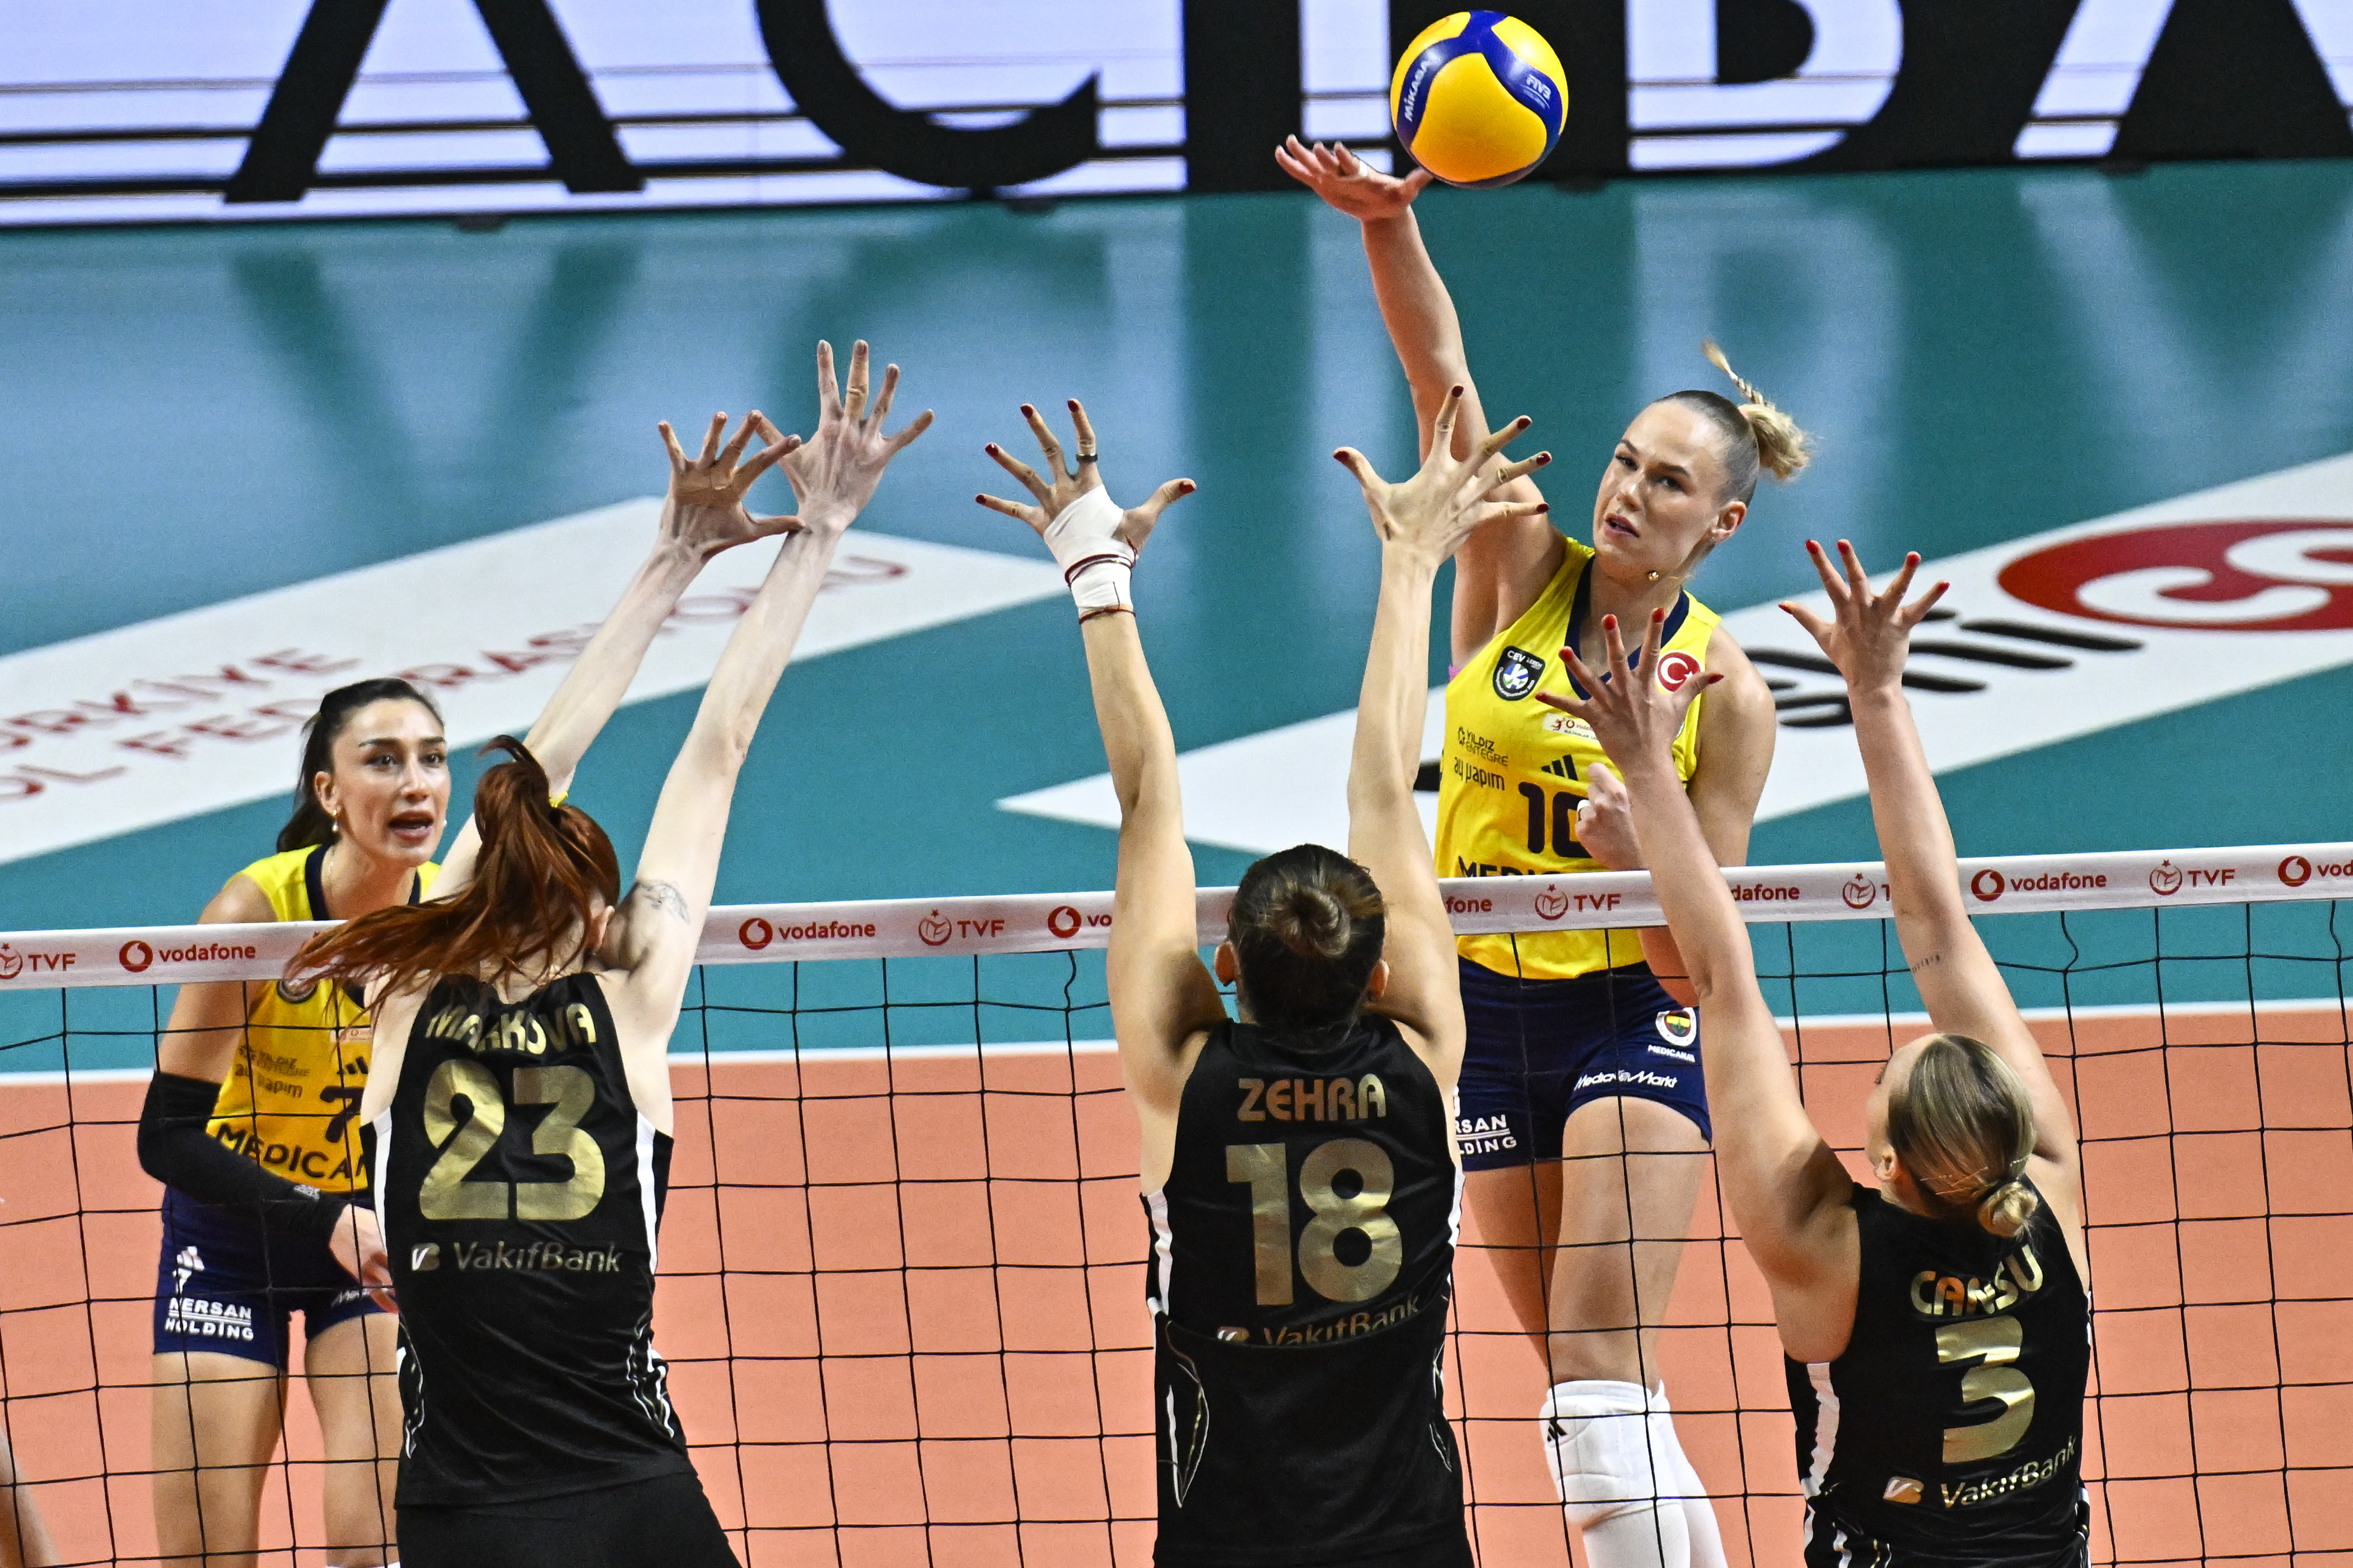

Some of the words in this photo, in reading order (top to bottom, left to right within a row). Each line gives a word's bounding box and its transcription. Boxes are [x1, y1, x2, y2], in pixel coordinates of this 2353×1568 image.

[1507, 650, 1526, 662] CEV
[1466, 742, 1509, 766] ENTEGRE
[1467, 729, 1495, 751] YILDIZ
[1574, 893, 1621, 911] TVF
[2011, 872, 2107, 891] vodafone
[2188, 869, 2235, 887] TVF
[779, 920, 876, 940] vodafone
[957, 920, 1005, 938] TVF
[28, 953, 76, 971] TVF
[159, 943, 256, 962] vodafone
[320, 1085, 365, 1143] 7
[1236, 1073, 1386, 1121] ZEHRA
[419, 1059, 605, 1220] 23
[1226, 1137, 1402, 1305] 18
[1911, 1244, 2043, 1316] CANSU
[164, 1317, 254, 1342] HOLDING
[1935, 1314, 2035, 1463] 3
